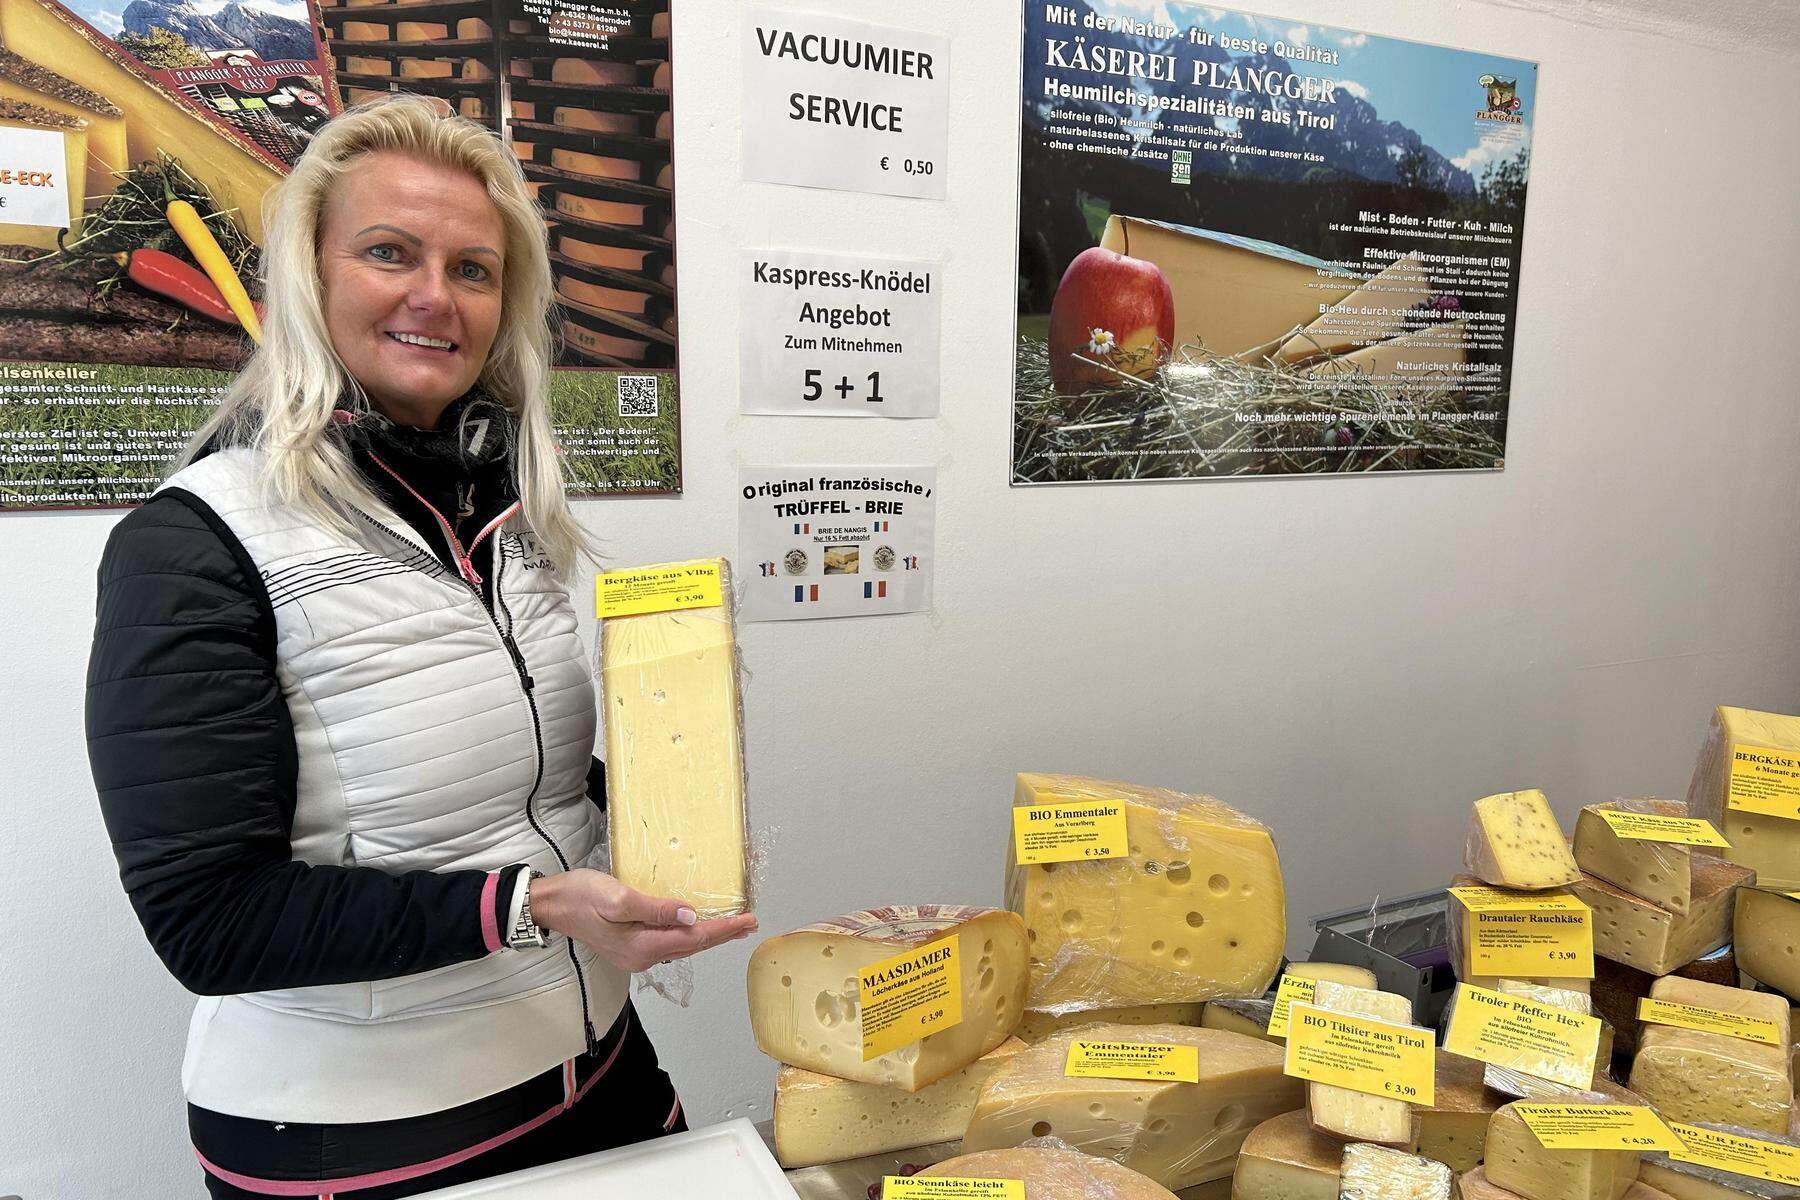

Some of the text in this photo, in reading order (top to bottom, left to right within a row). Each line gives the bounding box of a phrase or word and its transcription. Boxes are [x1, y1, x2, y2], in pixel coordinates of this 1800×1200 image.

[555, 0, 631, 17] Plangger Ges.m.b.H.
[560, 11, 586, 20] A-6342
[588, 14, 631, 26] Niederndorf
[549, 27, 608, 41] bio@kaeserei.at
[1046, 4, 1340, 66] Mit der Natur für beste Qualität
[549, 37, 608, 50] www.kaeserei.at
[756, 27, 933, 79] VACUUMIER
[1045, 35, 1337, 104] KÄSEREI PLANGGER
[1044, 78, 1335, 130] Heumilchspezialitäten aus Tirol
[790, 93, 902, 132] SERVICE
[1476, 112, 1521, 123] PLANGGER
[1050, 109, 1243, 139] silofreie (Bio) Heumilch natürliches Lab
[1050, 125, 1325, 163] naturbelassenes Kristallsalz für die Produktion unserer Käse
[1050, 140, 1168, 160] ohne chemische Zusätze
[1173, 151, 1191, 162] OHNE
[880, 157, 933, 175] € 0,50
[1172, 163, 1190, 178] gen
[0, 170, 53, 187] E-ECK
[1359, 210, 1513, 234] Mist Boden Futter Kuh Milch
[1364, 247, 1510, 268] Effektive Mikroorganismen (EM)
[754, 261, 930, 293] Kaspress-Knödel
[799, 302, 890, 329] Angebot
[1320, 304, 1358, 314] Bio-Heu
[1361, 306, 1388, 315] durch
[1444, 309, 1505, 323] Heutrocknung
[785, 335, 902, 353] Zum Mitnehmen
[0, 367, 98, 379] lsenkeller
[1452, 362, 1502, 372] Kristallsalz
[64, 384, 206, 394] Schnitt- und Hartkäse
[803, 369, 822, 401] 5
[866, 371, 883, 402] 1
[45, 397, 100, 405] erhalten
[106, 397, 126, 405] wir
[131, 397, 150, 405] die
[156, 397, 198, 405] höchst
[1235, 412, 1262, 423] Noch
[1265, 412, 1292, 422] mehr
[1294, 411, 1337, 423] wichtige
[1340, 411, 1416, 422] Spurenelemente
[1418, 411, 1429, 421] im
[574, 448, 638, 456] hochwertiges
[774, 500, 903, 517] TRÜFFEL BRIE
[604, 574, 659, 585] Bergkäse
[1735, 752, 1794, 767] BERGKÄSE
[1763, 766, 1790, 776] Monate
[1030, 807, 1118, 820] BIO Emmentaler
[1094, 848, 1110, 856] 3,50
[1480, 913, 1583, 924] Drautaler Rauchkäse
[1549, 951, 1576, 960] € 3,90
[863, 947, 951, 989] MAASDAMER
[872, 964, 944, 997] Löcherkäse aus Holland
[1469, 991, 1510, 1009] Tiroler
[1512, 1002, 1553, 1020] Pfeffer
[921, 1009, 943, 1024] € 3,90
[1516, 1015, 1532, 1023] BIO
[1304, 1015, 1425, 1048] BIO Tilsiter aus Tirol
[1080, 1043, 1174, 1052] Voitsberger
[1384, 1082, 1416, 1096] € 3,90
[1517, 1107, 1633, 1117] Tiroler Butterkäse
[1633, 1137, 1655, 1145] 4,20
[1673, 1127, 1698, 1137] BIO
[1706, 1134, 1726, 1143] UR
[1763, 1146, 1794, 1157] Käse
[917, 1180, 969, 1188] Sennkäse
